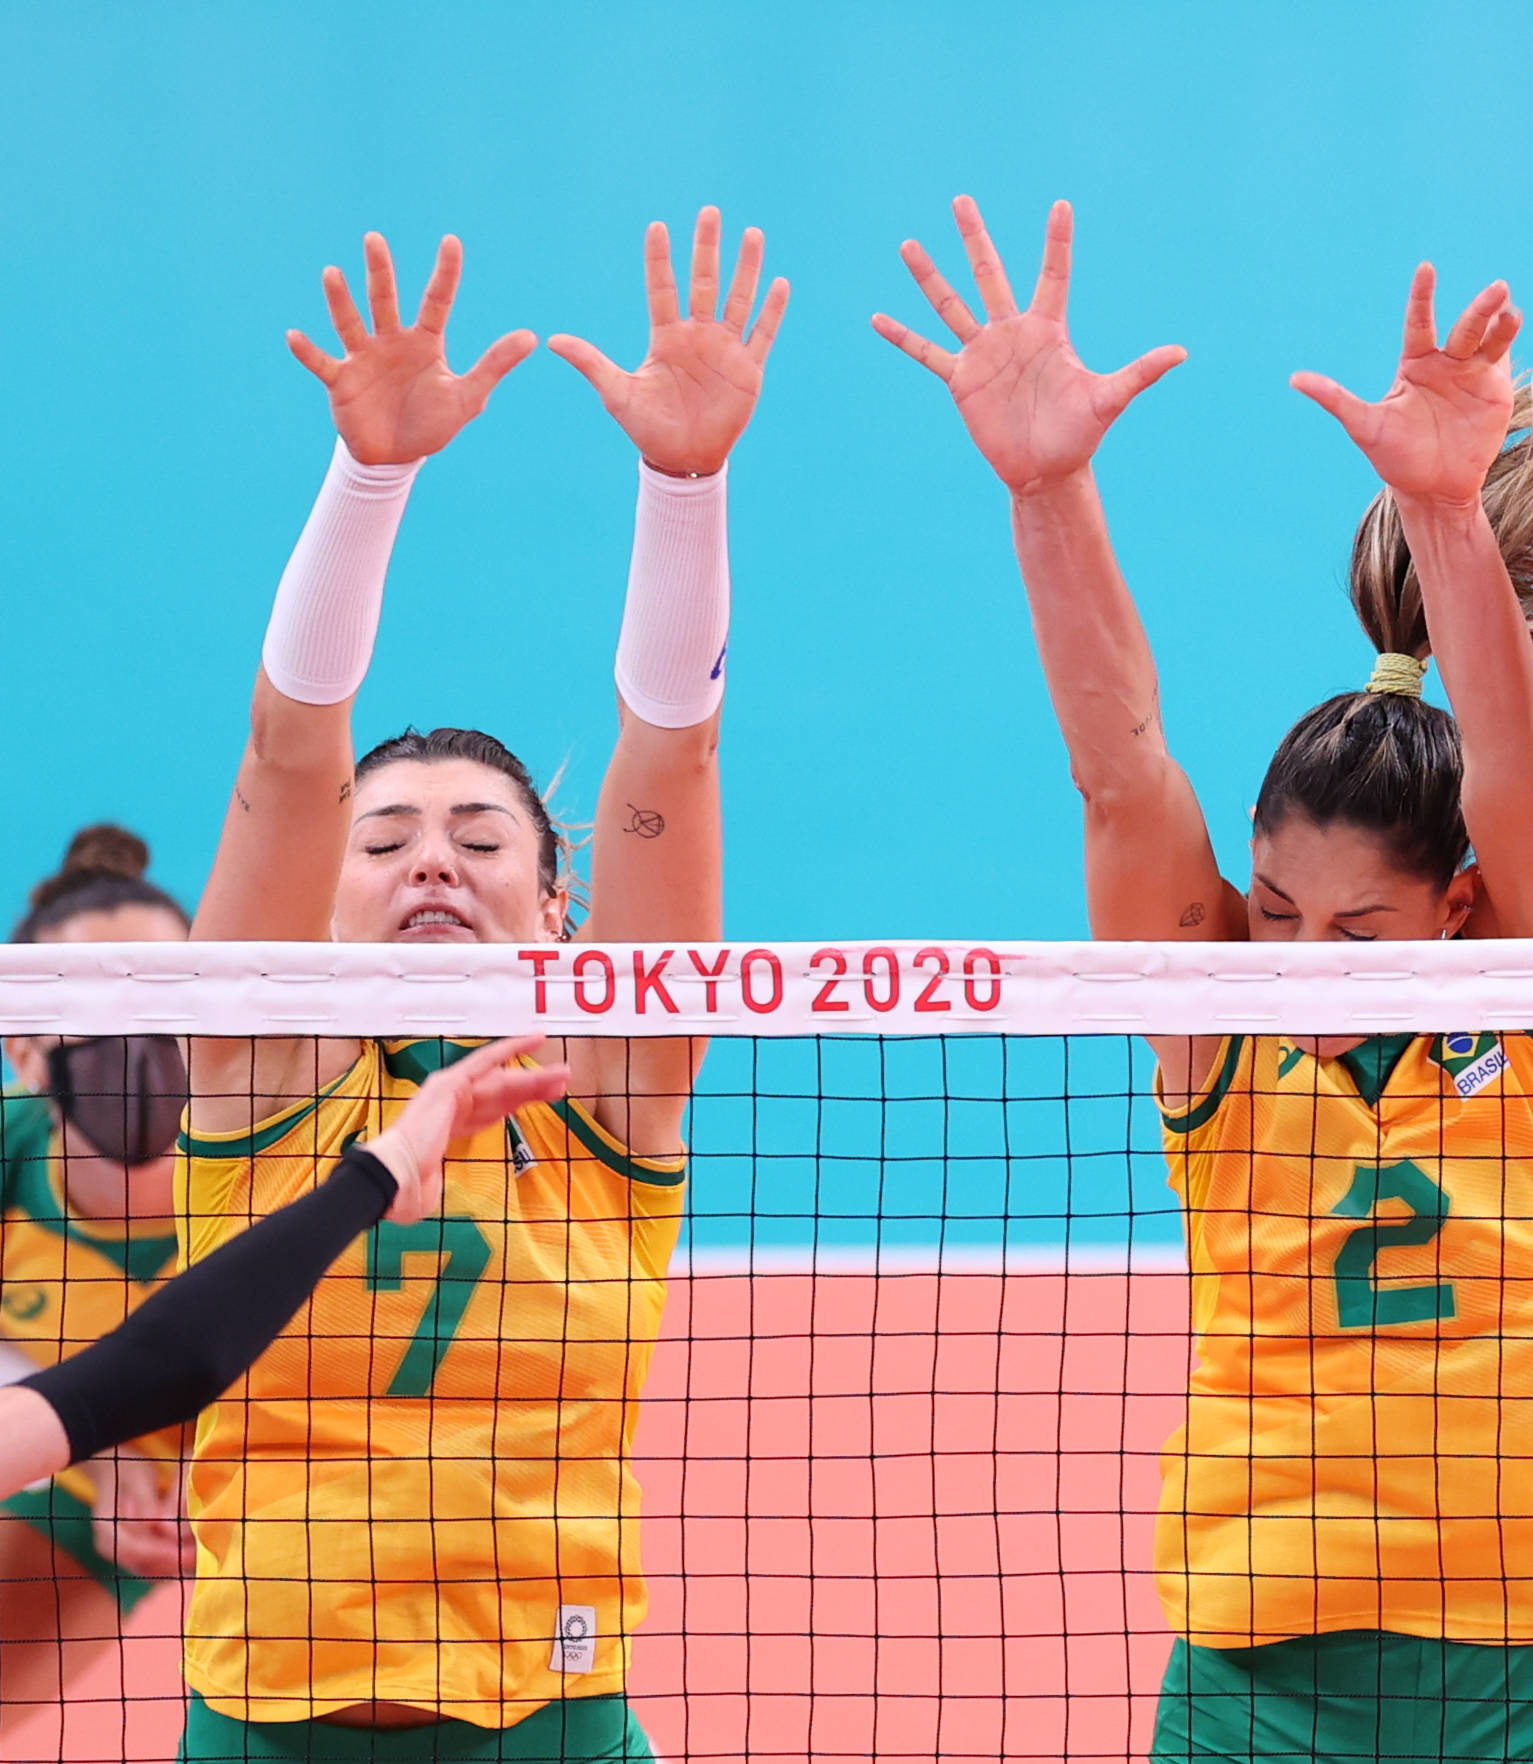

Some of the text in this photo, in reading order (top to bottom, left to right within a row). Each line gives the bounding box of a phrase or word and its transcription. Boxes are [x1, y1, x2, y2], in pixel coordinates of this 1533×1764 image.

[518, 946, 1001, 1014] TOKYO 2020
[1457, 1051, 1509, 1095] BRASIL
[1330, 1158, 1456, 1328] 2
[366, 1215, 493, 1396] 7
